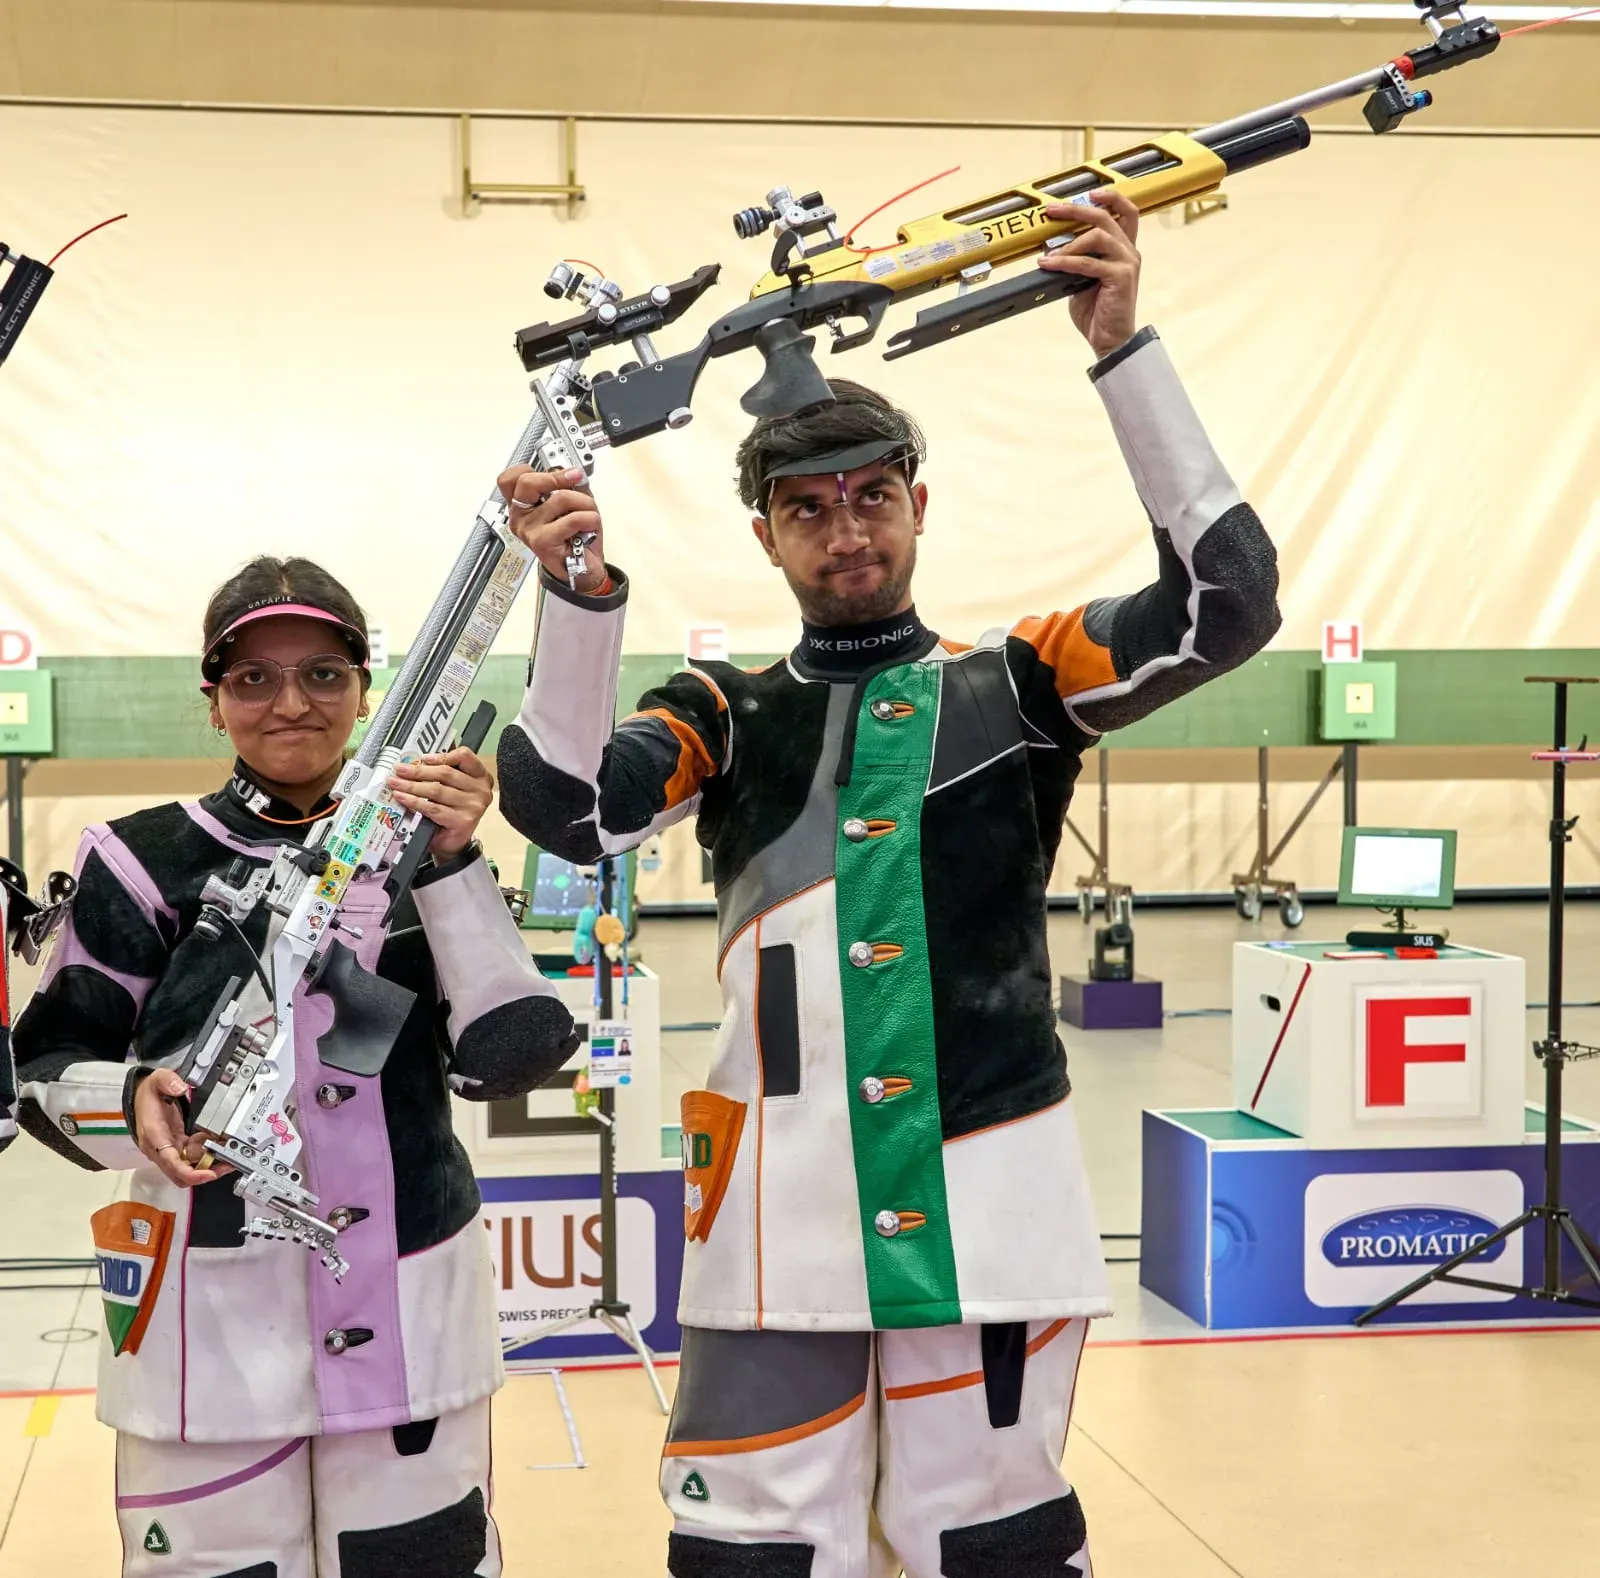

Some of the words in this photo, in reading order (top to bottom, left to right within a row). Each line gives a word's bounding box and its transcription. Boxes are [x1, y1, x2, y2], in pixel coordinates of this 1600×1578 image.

[0, 630, 32, 665] D
[689, 629, 723, 660] F
[1327, 625, 1358, 658] H
[1413, 935, 1434, 947] SIUS
[1365, 997, 1471, 1107] F
[484, 1213, 603, 1290] IUS
[1340, 1232, 1489, 1259] PROMATIC
[498, 1309, 538, 1323] SWISS
